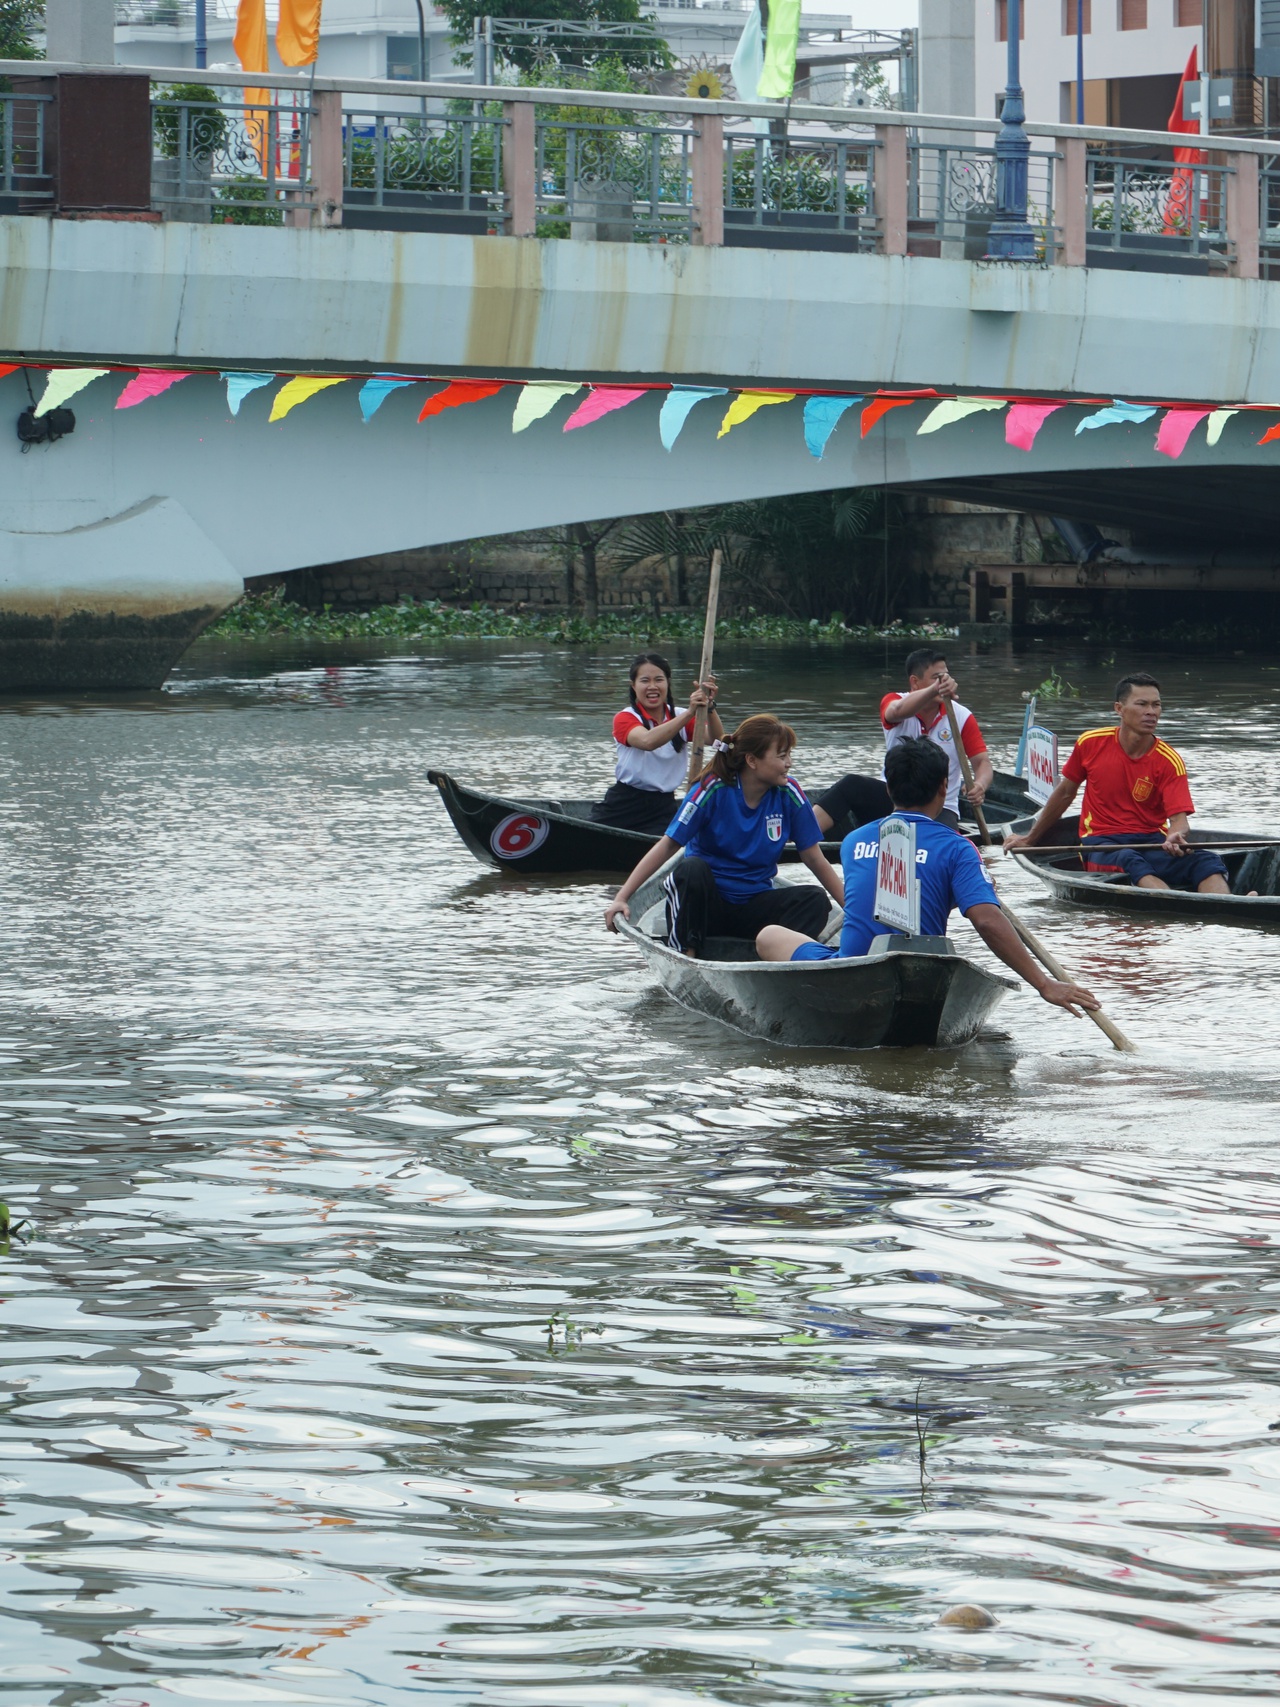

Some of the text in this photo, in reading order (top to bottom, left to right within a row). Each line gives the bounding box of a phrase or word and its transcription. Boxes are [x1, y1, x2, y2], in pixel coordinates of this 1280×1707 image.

[498, 814, 542, 853] 6
[854, 841, 880, 860] Đứ
[880, 842, 893, 893] ĐỨC
